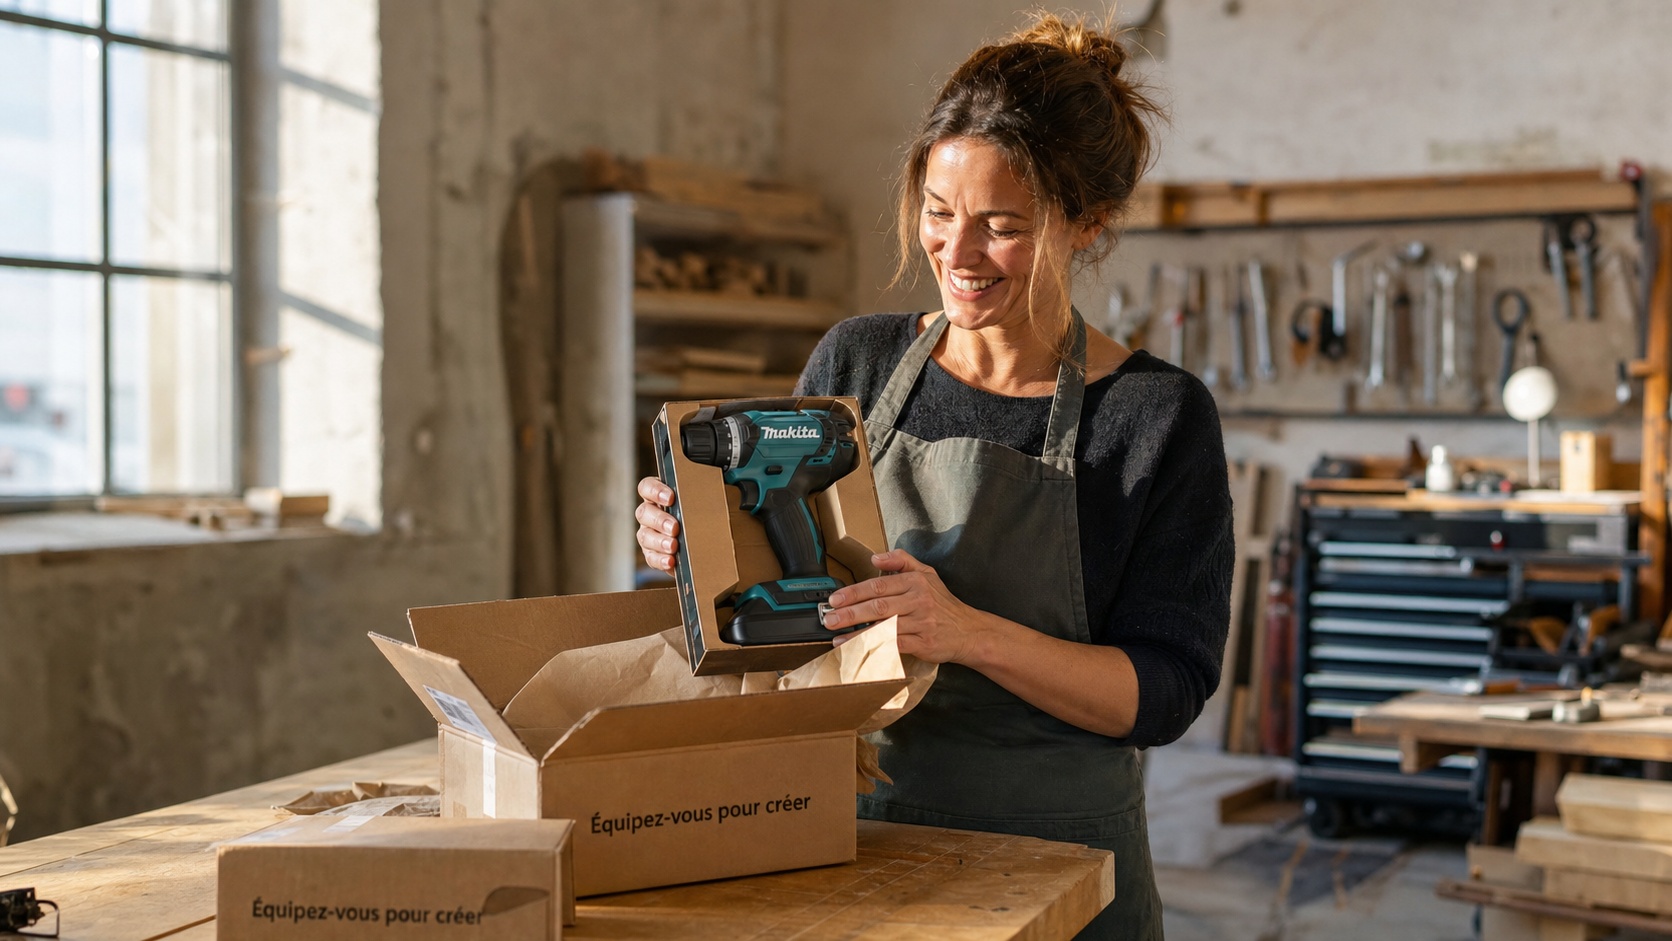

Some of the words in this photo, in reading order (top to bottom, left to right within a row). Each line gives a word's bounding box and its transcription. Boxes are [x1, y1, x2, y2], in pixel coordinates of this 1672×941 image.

[591, 808, 713, 837] Équipez-vous
[719, 801, 761, 823] pour
[765, 794, 812, 813] créer
[252, 897, 380, 924] Équipez-vous
[385, 905, 430, 926] pour
[435, 905, 483, 925] créer
